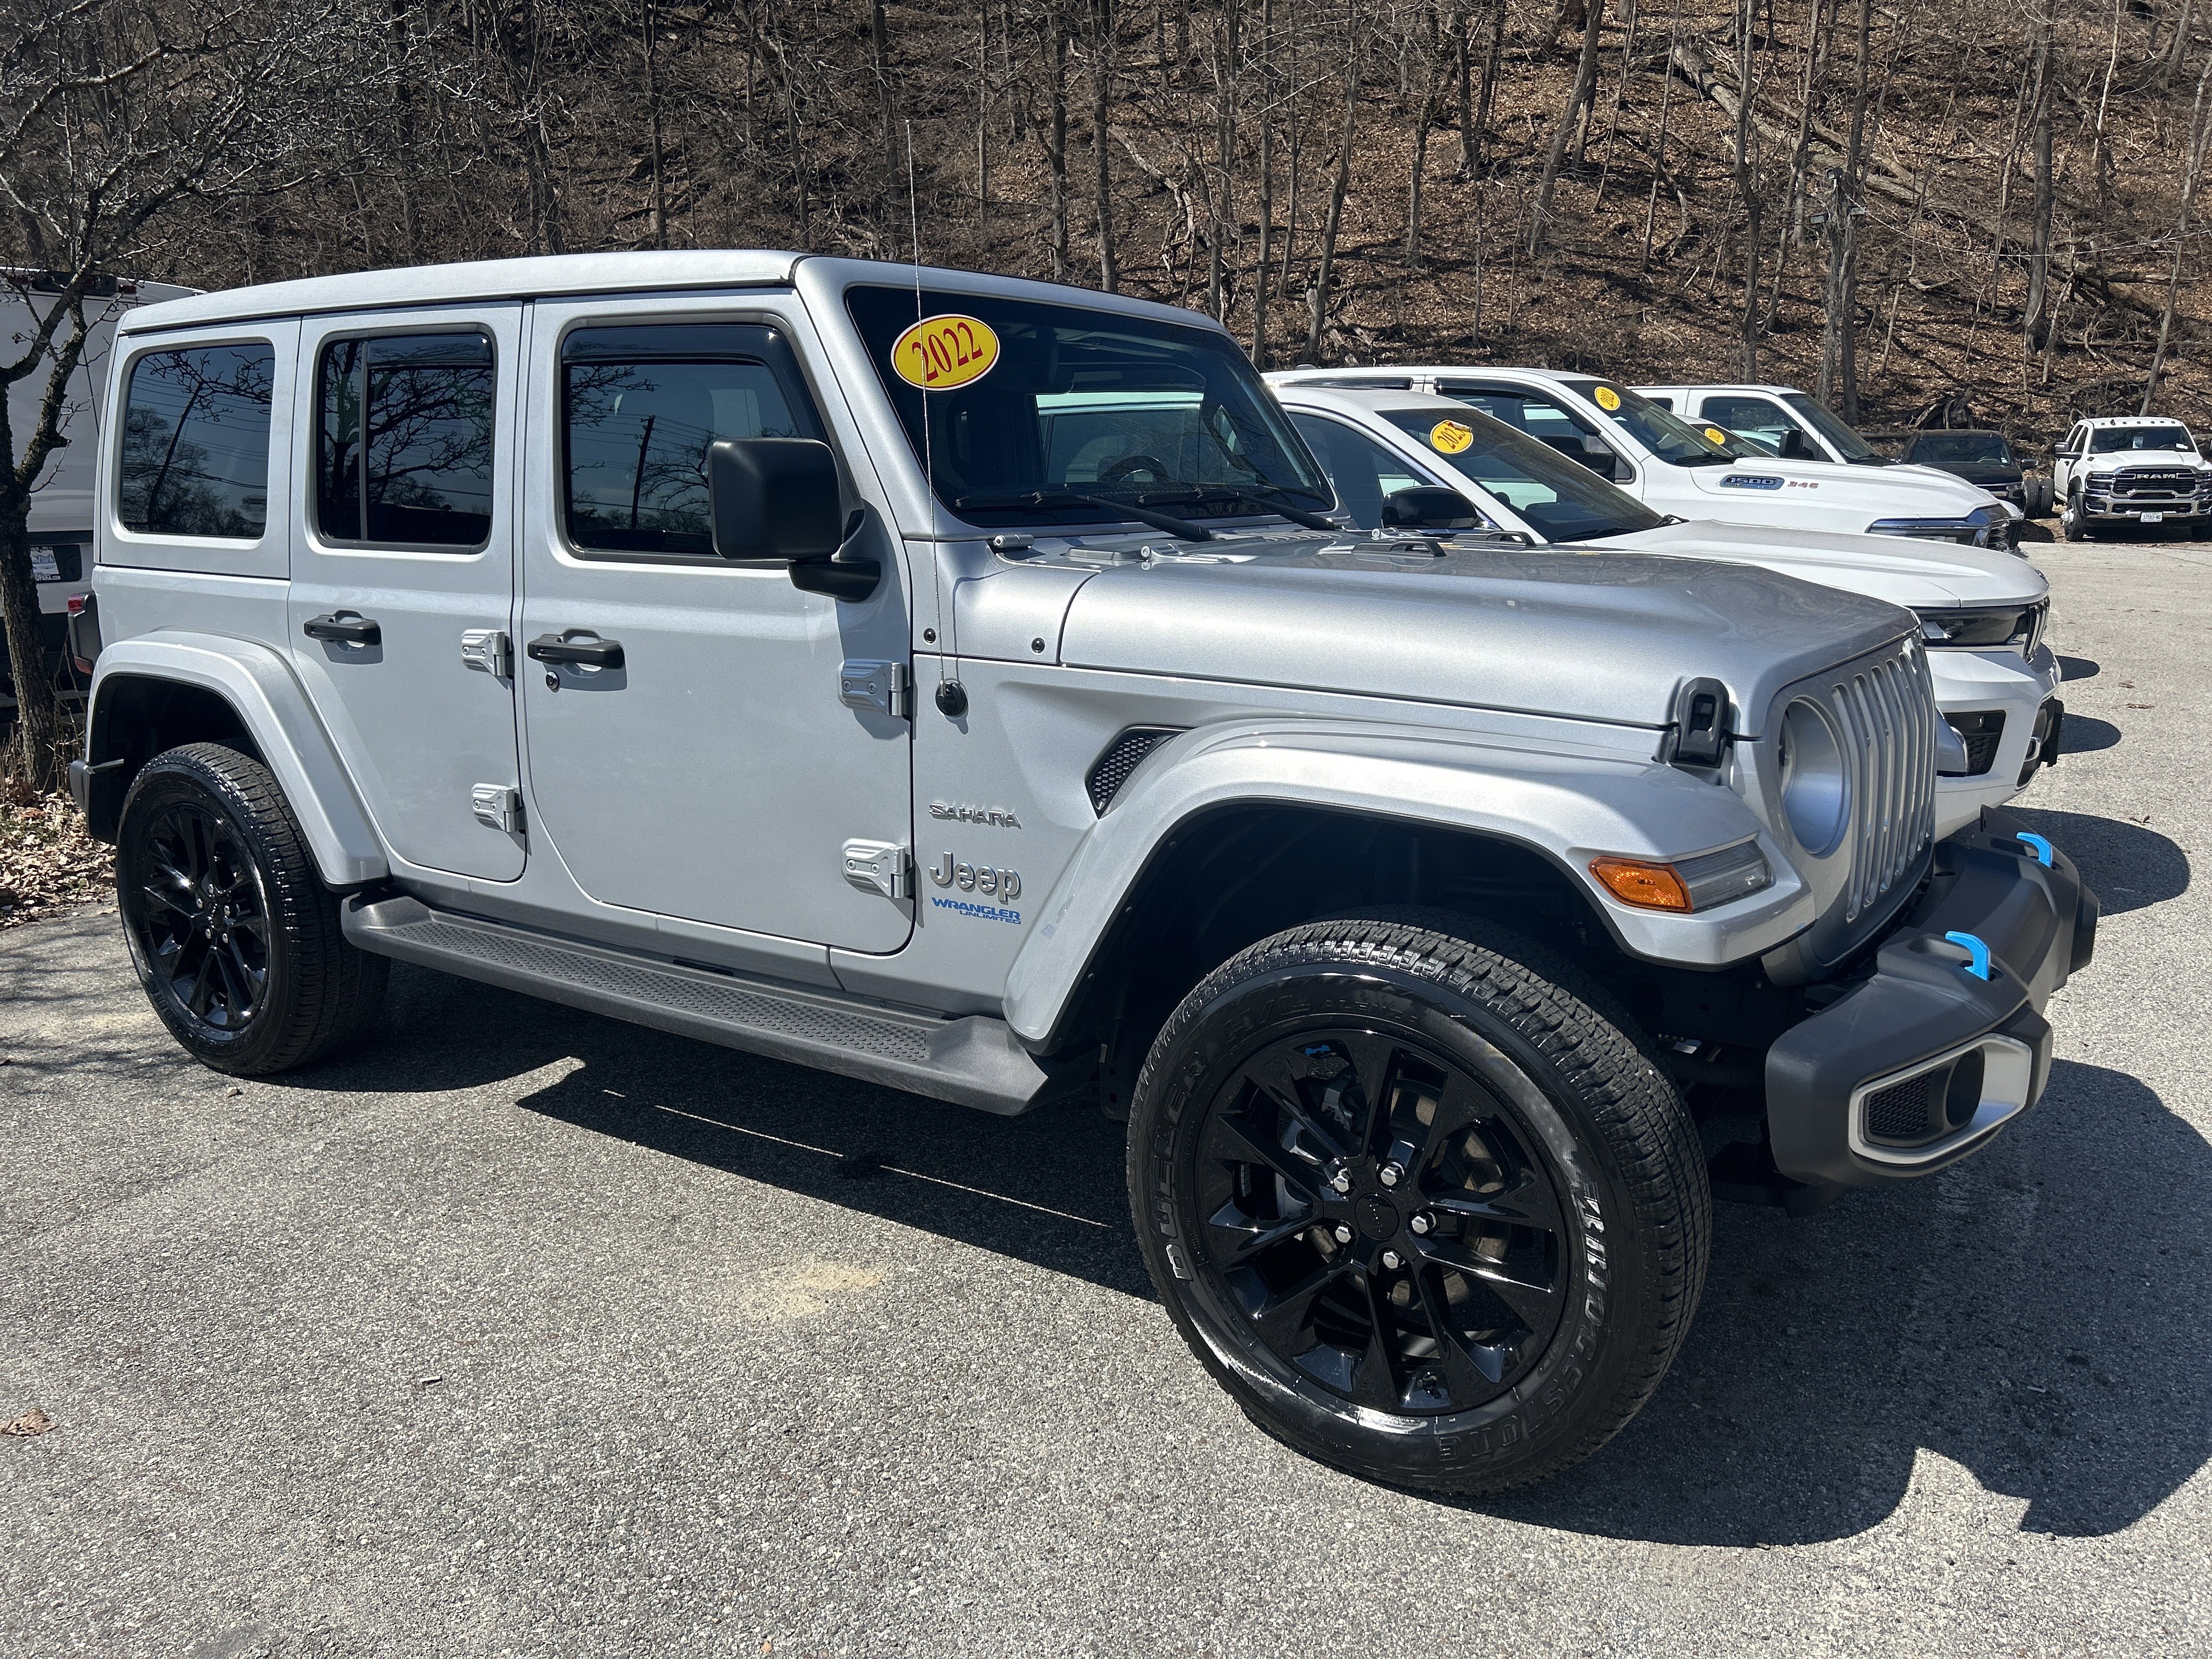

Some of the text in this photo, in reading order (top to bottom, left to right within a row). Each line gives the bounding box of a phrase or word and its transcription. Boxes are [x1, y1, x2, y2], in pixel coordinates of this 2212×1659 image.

[911, 322, 984, 382] 2022
[1729, 476, 1775, 485] 1500
[928, 803, 1022, 829] SAHARA
[929, 851, 1021, 903] Jeep
[932, 897, 1020, 920] WRANGLER
[960, 910, 1021, 924] UNLIMITED
[1154, 1051, 1206, 1282] DUELER
